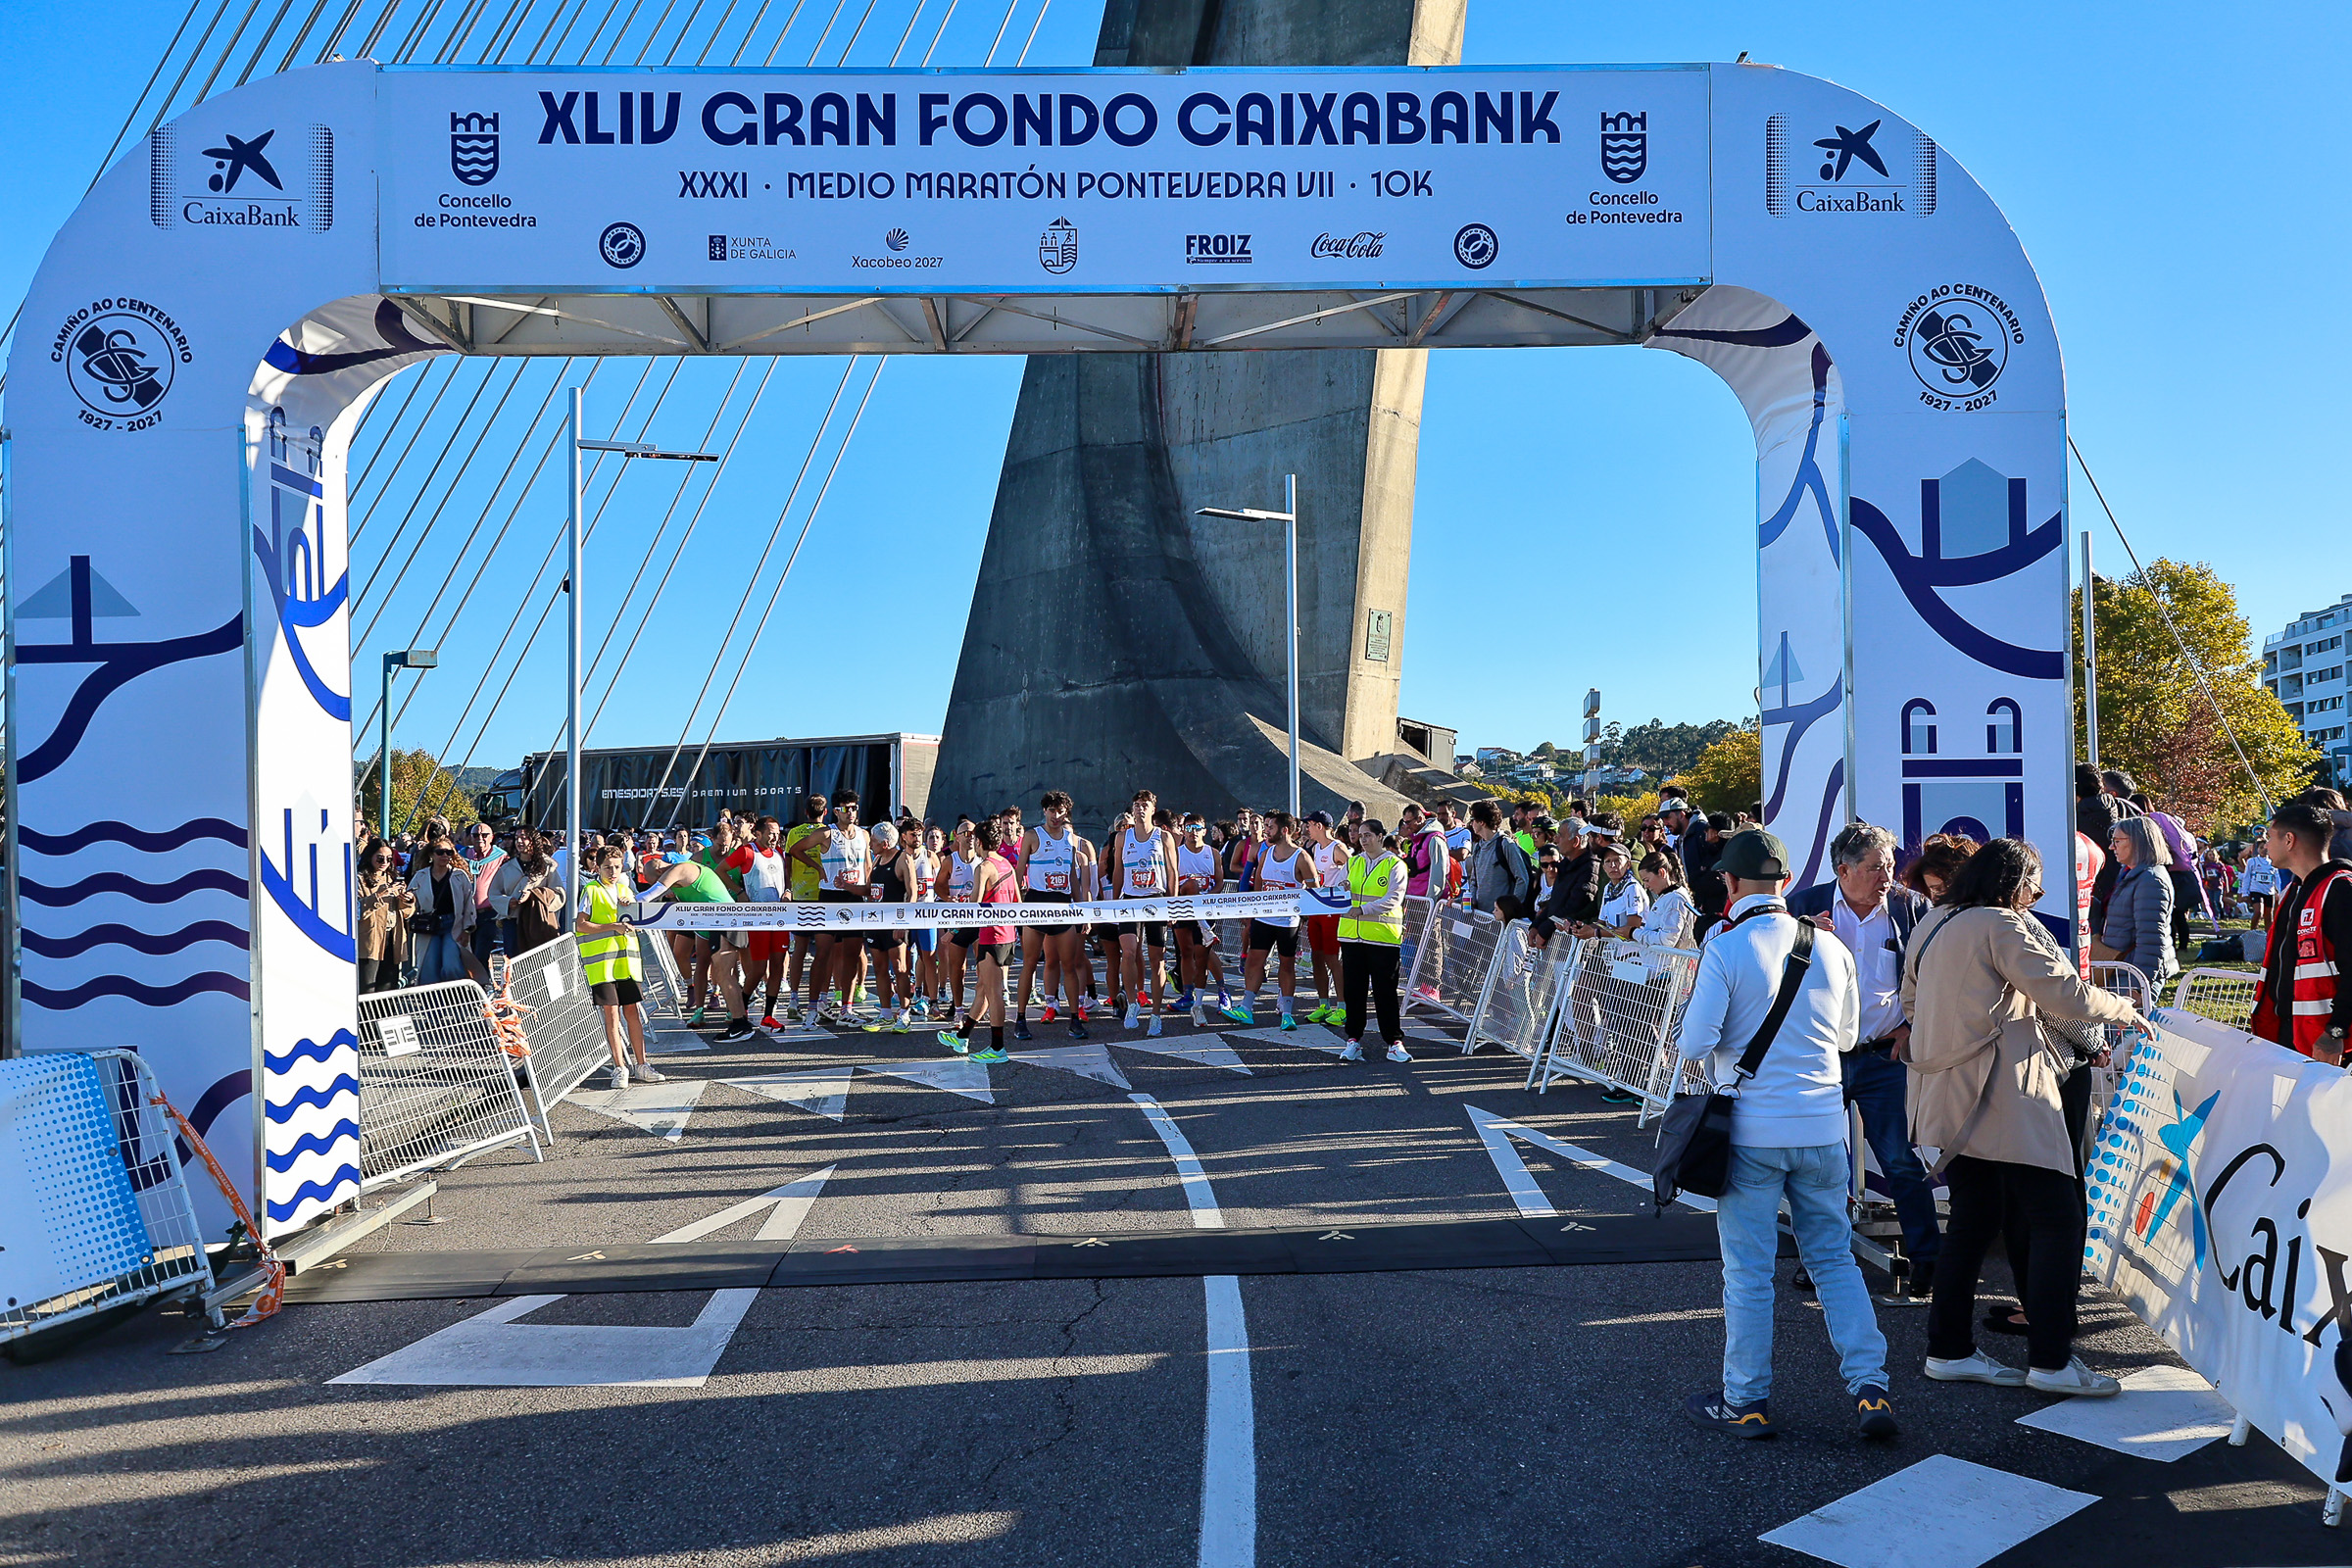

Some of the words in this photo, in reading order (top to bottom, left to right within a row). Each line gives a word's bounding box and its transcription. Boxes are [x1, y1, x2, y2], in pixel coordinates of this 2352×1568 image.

[538, 91, 681, 144] XLIV
[702, 92, 896, 146] GRAN
[919, 93, 1157, 146] FONDO
[1178, 91, 1560, 146] CAIXABANK
[679, 172, 747, 198] XXXI
[788, 172, 895, 198] MEDIO
[906, 164, 1065, 198] MARATÓN
[1078, 172, 1285, 198] PONTEVEDRA
[1298, 172, 1333, 197] VII
[1371, 171, 1432, 197] 10K
[439, 193, 512, 209] Concello
[1589, 190, 1658, 205] Concello
[1795, 190, 1906, 213] CaixaBank
[183, 201, 300, 227] CaixaBank
[414, 213, 436, 227] de
[439, 213, 537, 227] Pontevedra
[1567, 210, 1587, 224] de
[1591, 210, 1683, 224] Pontevedra
[732, 236, 771, 247] XUNTA
[1186, 234, 1251, 255] FROIZ
[1311, 231, 1388, 259] Coca-Cola
[731, 249, 745, 259] DE
[750, 249, 796, 259] GALICIA
[852, 255, 911, 269] Xacobeo
[915, 256, 944, 268] 2027
[1893, 292, 1928, 348] CAMIÑO
[1931, 283, 1950, 300] AO
[1953, 282, 2025, 346] CENTENARIO
[50, 306, 90, 364] CAMIÑO
[91, 297, 114, 314] AO
[116, 296, 193, 365] CENTENARIO
[1919, 390, 1951, 412] 1927
[1964, 390, 1998, 412] 2027
[76, 408, 113, 431] 1927
[127, 409, 164, 432] 2027
[601, 786, 683, 800] EMESPORTS.ES
[691, 788, 747, 799] PREMIUM
[754, 786, 802, 796] SPORTS
[1050, 875, 1066, 885] 2167
[914, 908, 939, 918] XLIV
[941, 908, 973, 919] GRAN
[977, 908, 1016, 919] FONDO
[1020, 908, 1085, 918] CAIXABANK
